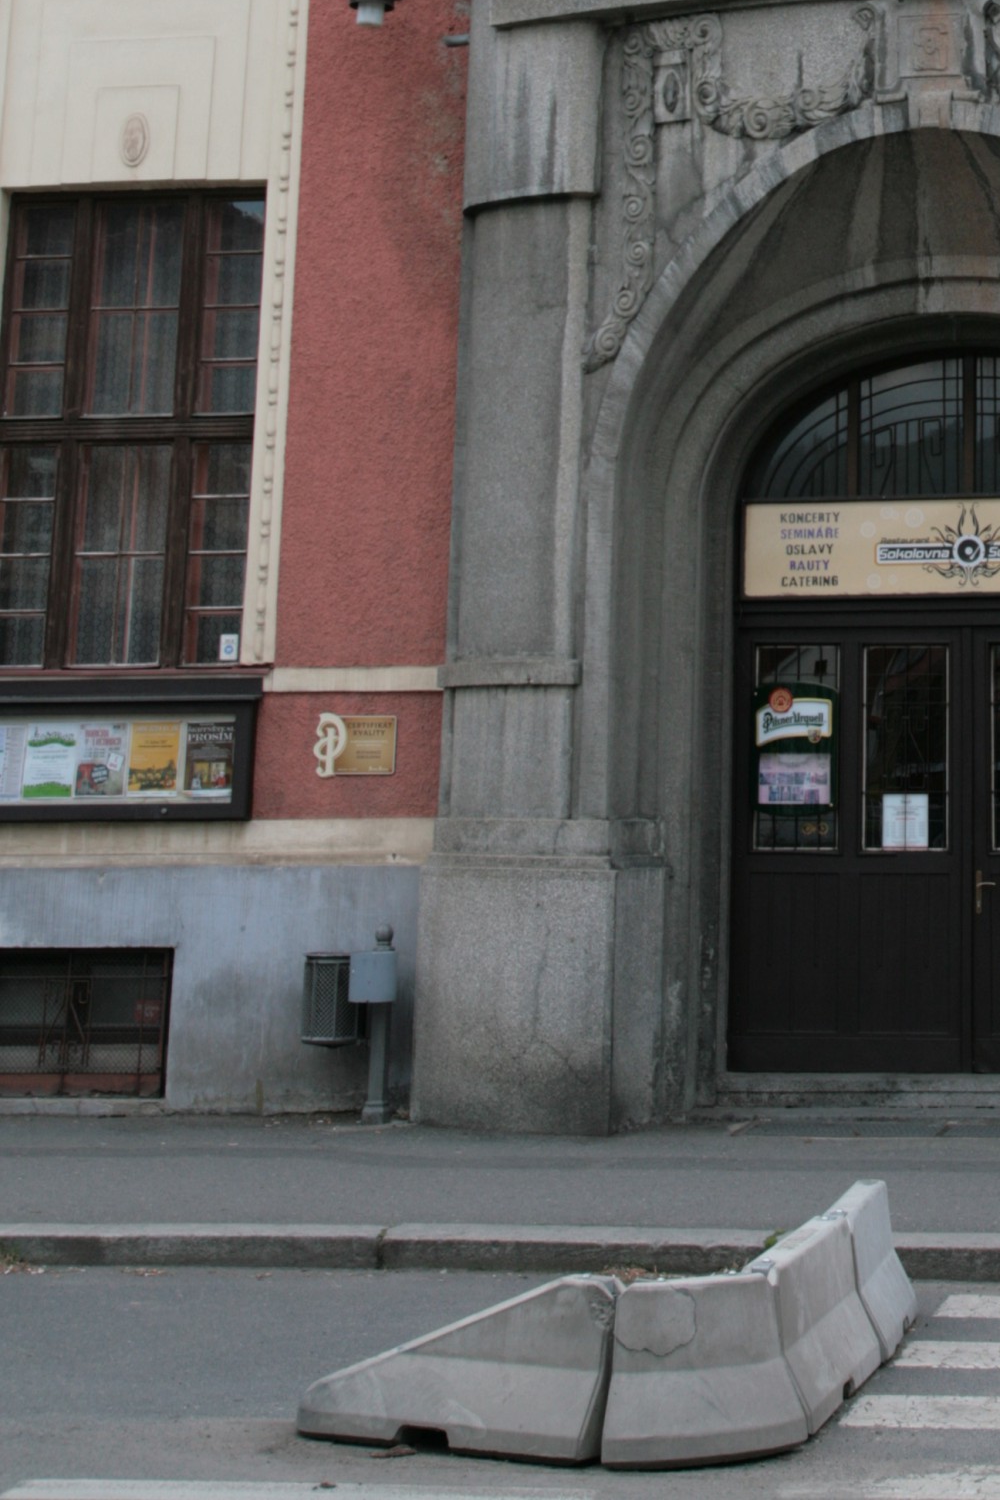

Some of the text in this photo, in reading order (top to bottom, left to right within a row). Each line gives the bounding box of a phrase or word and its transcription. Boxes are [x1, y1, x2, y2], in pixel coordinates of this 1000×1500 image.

[780, 511, 840, 524] KONCERTY
[786, 543, 834, 556] OSLAVY
[880, 548, 950, 560] Sokolovna
[789, 559, 830, 571] RAUTY
[781, 575, 839, 588] CATERING
[763, 711, 823, 734] Pilsner Urquell
[188, 731, 233, 742] PROSÍM
